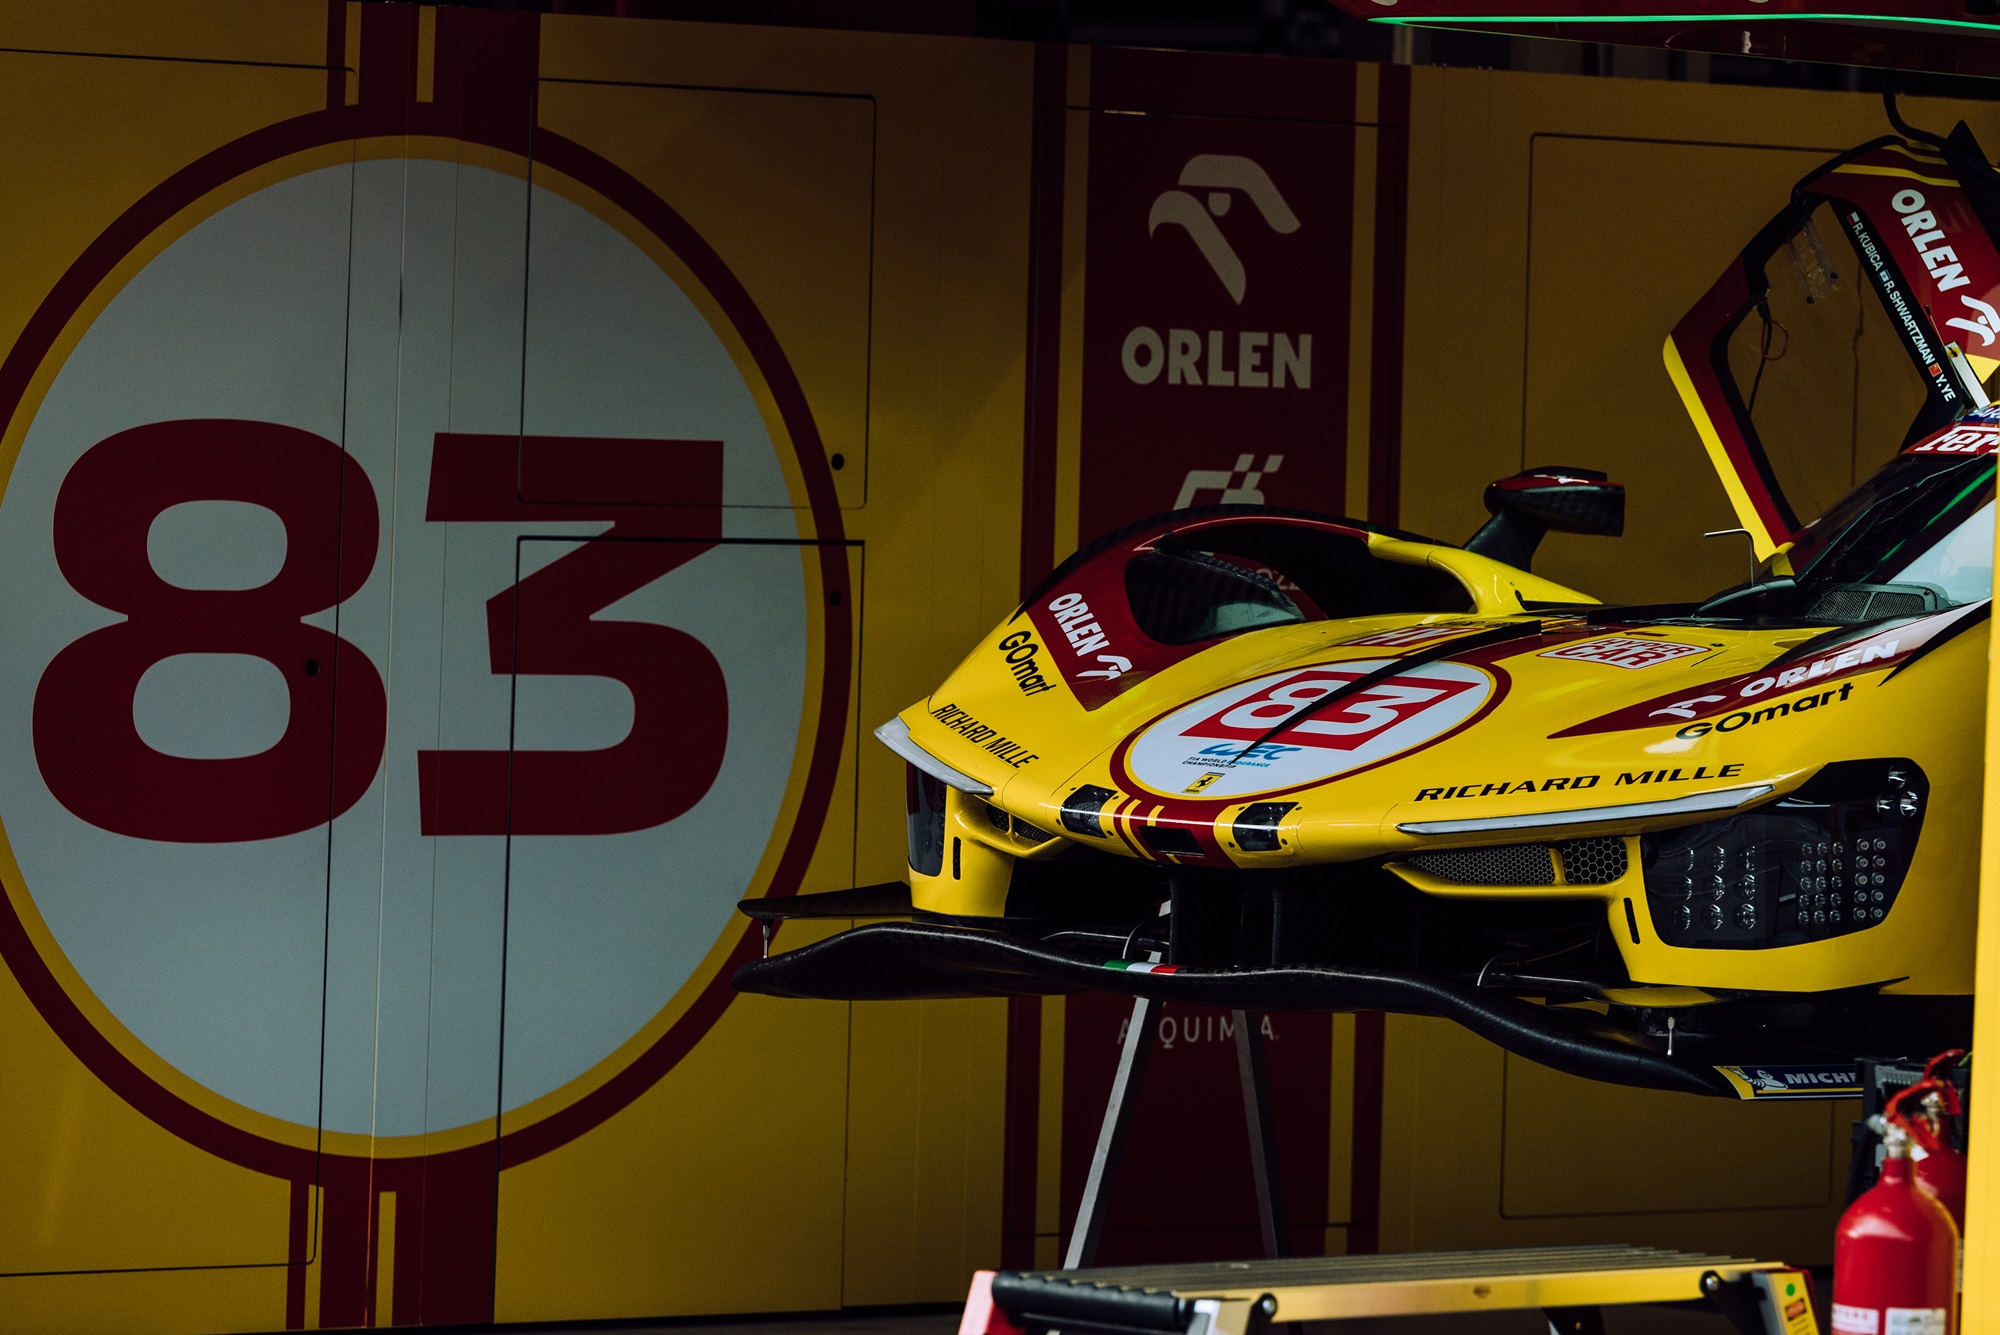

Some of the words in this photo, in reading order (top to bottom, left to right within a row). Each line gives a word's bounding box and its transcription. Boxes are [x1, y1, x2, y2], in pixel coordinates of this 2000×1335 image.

[1891, 189, 1971, 292] ORLEN
[1120, 325, 1312, 390] ORLEN
[1883, 280, 1935, 365] R.SHWARTZMAN
[1935, 374, 1956, 402] Y.YE
[33, 419, 729, 843] 83
[1048, 592, 1110, 657] ORLEN
[1593, 638, 1696, 655] HYPER
[998, 630, 1056, 697] GOmart
[1554, 645, 1667, 666] CAR
[1739, 640, 1899, 699] ORLEN
[931, 703, 997, 744] RICHARD
[982, 736, 1039, 769] MILLE
[1219, 679, 1450, 736] 83
[1674, 681, 1854, 740] GOmart
[1198, 743, 1303, 760] WEC
[1413, 775, 1600, 802] RICHARD
[1614, 763, 1744, 786] MILLE
[1116, 1013, 1274, 1049] AQUIMA
